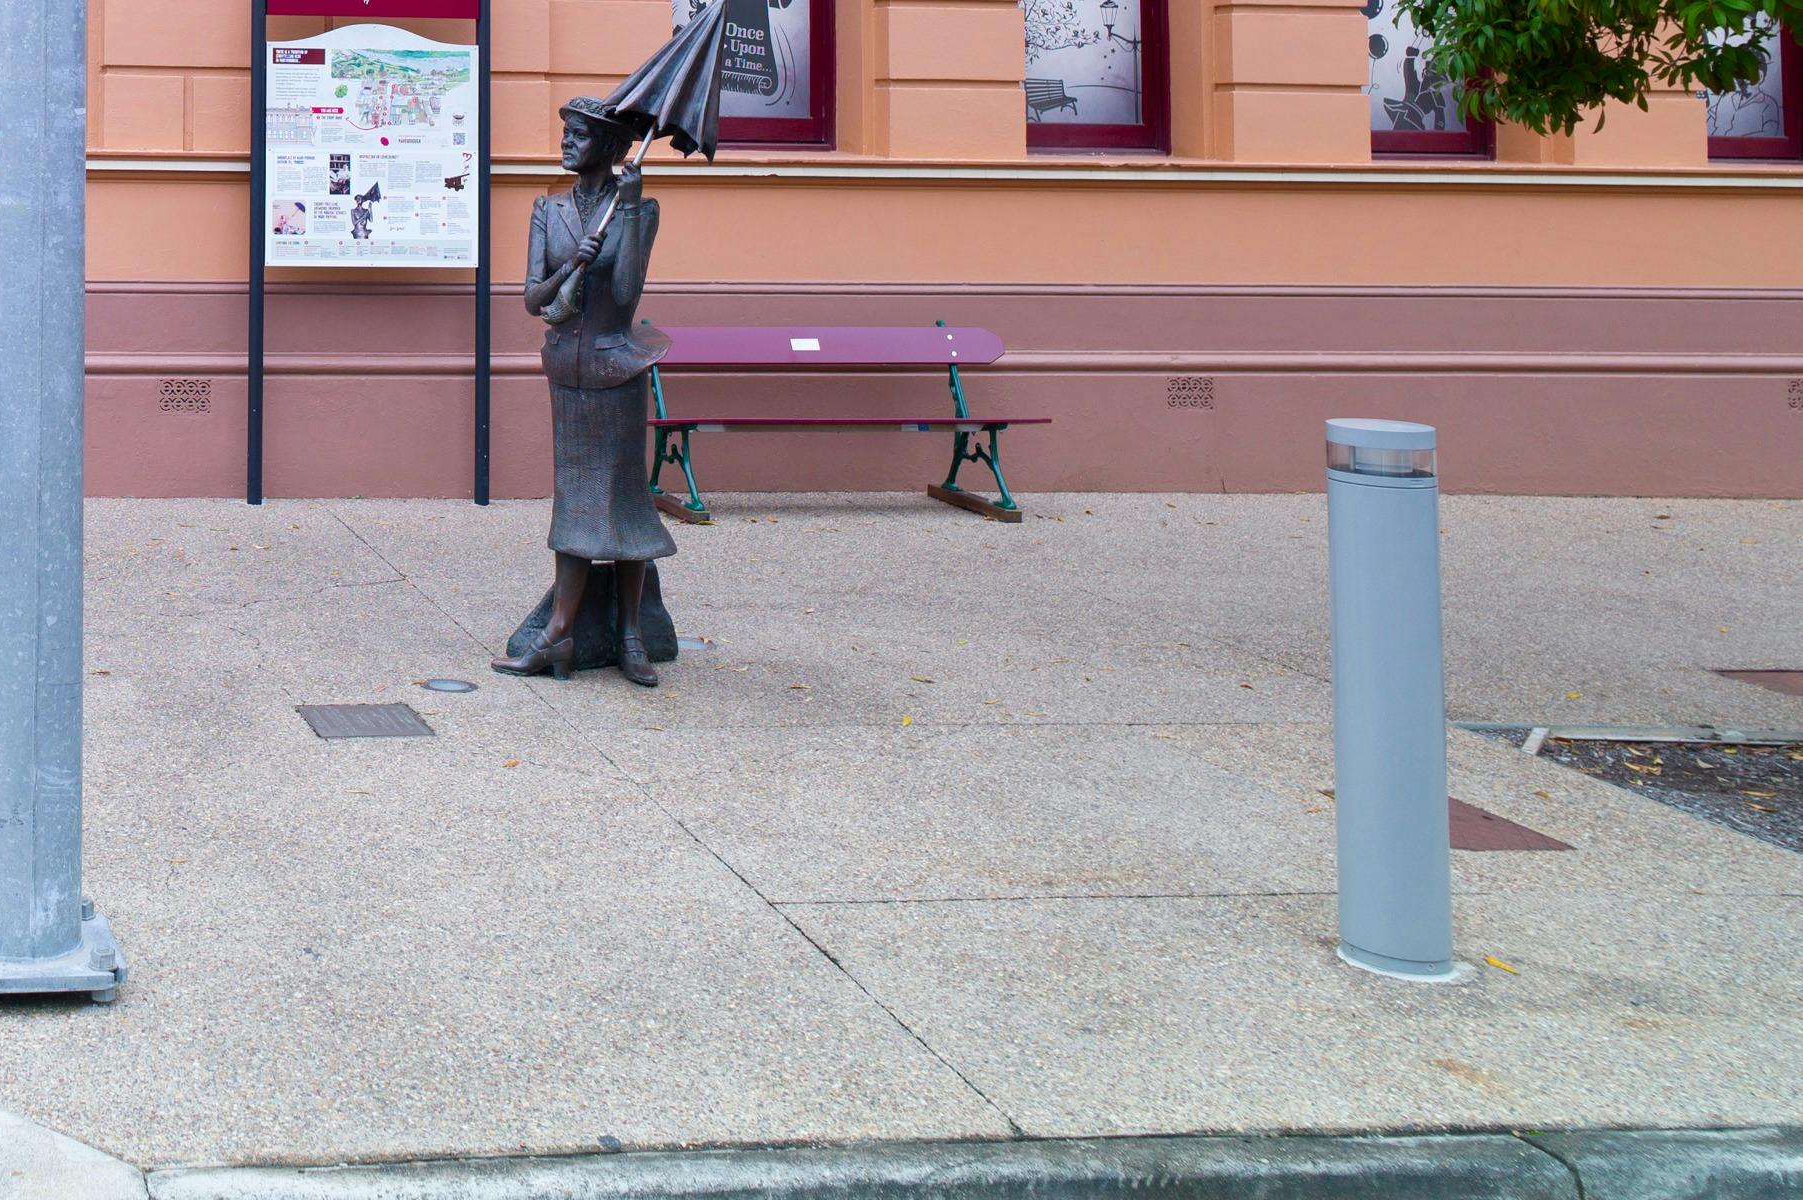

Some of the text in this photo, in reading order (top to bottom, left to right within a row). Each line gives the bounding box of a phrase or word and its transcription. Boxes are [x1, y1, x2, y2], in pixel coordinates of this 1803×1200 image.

[725, 22, 764, 40] Once
[730, 39, 766, 56] Upon
[724, 57, 772, 72] a Time...
